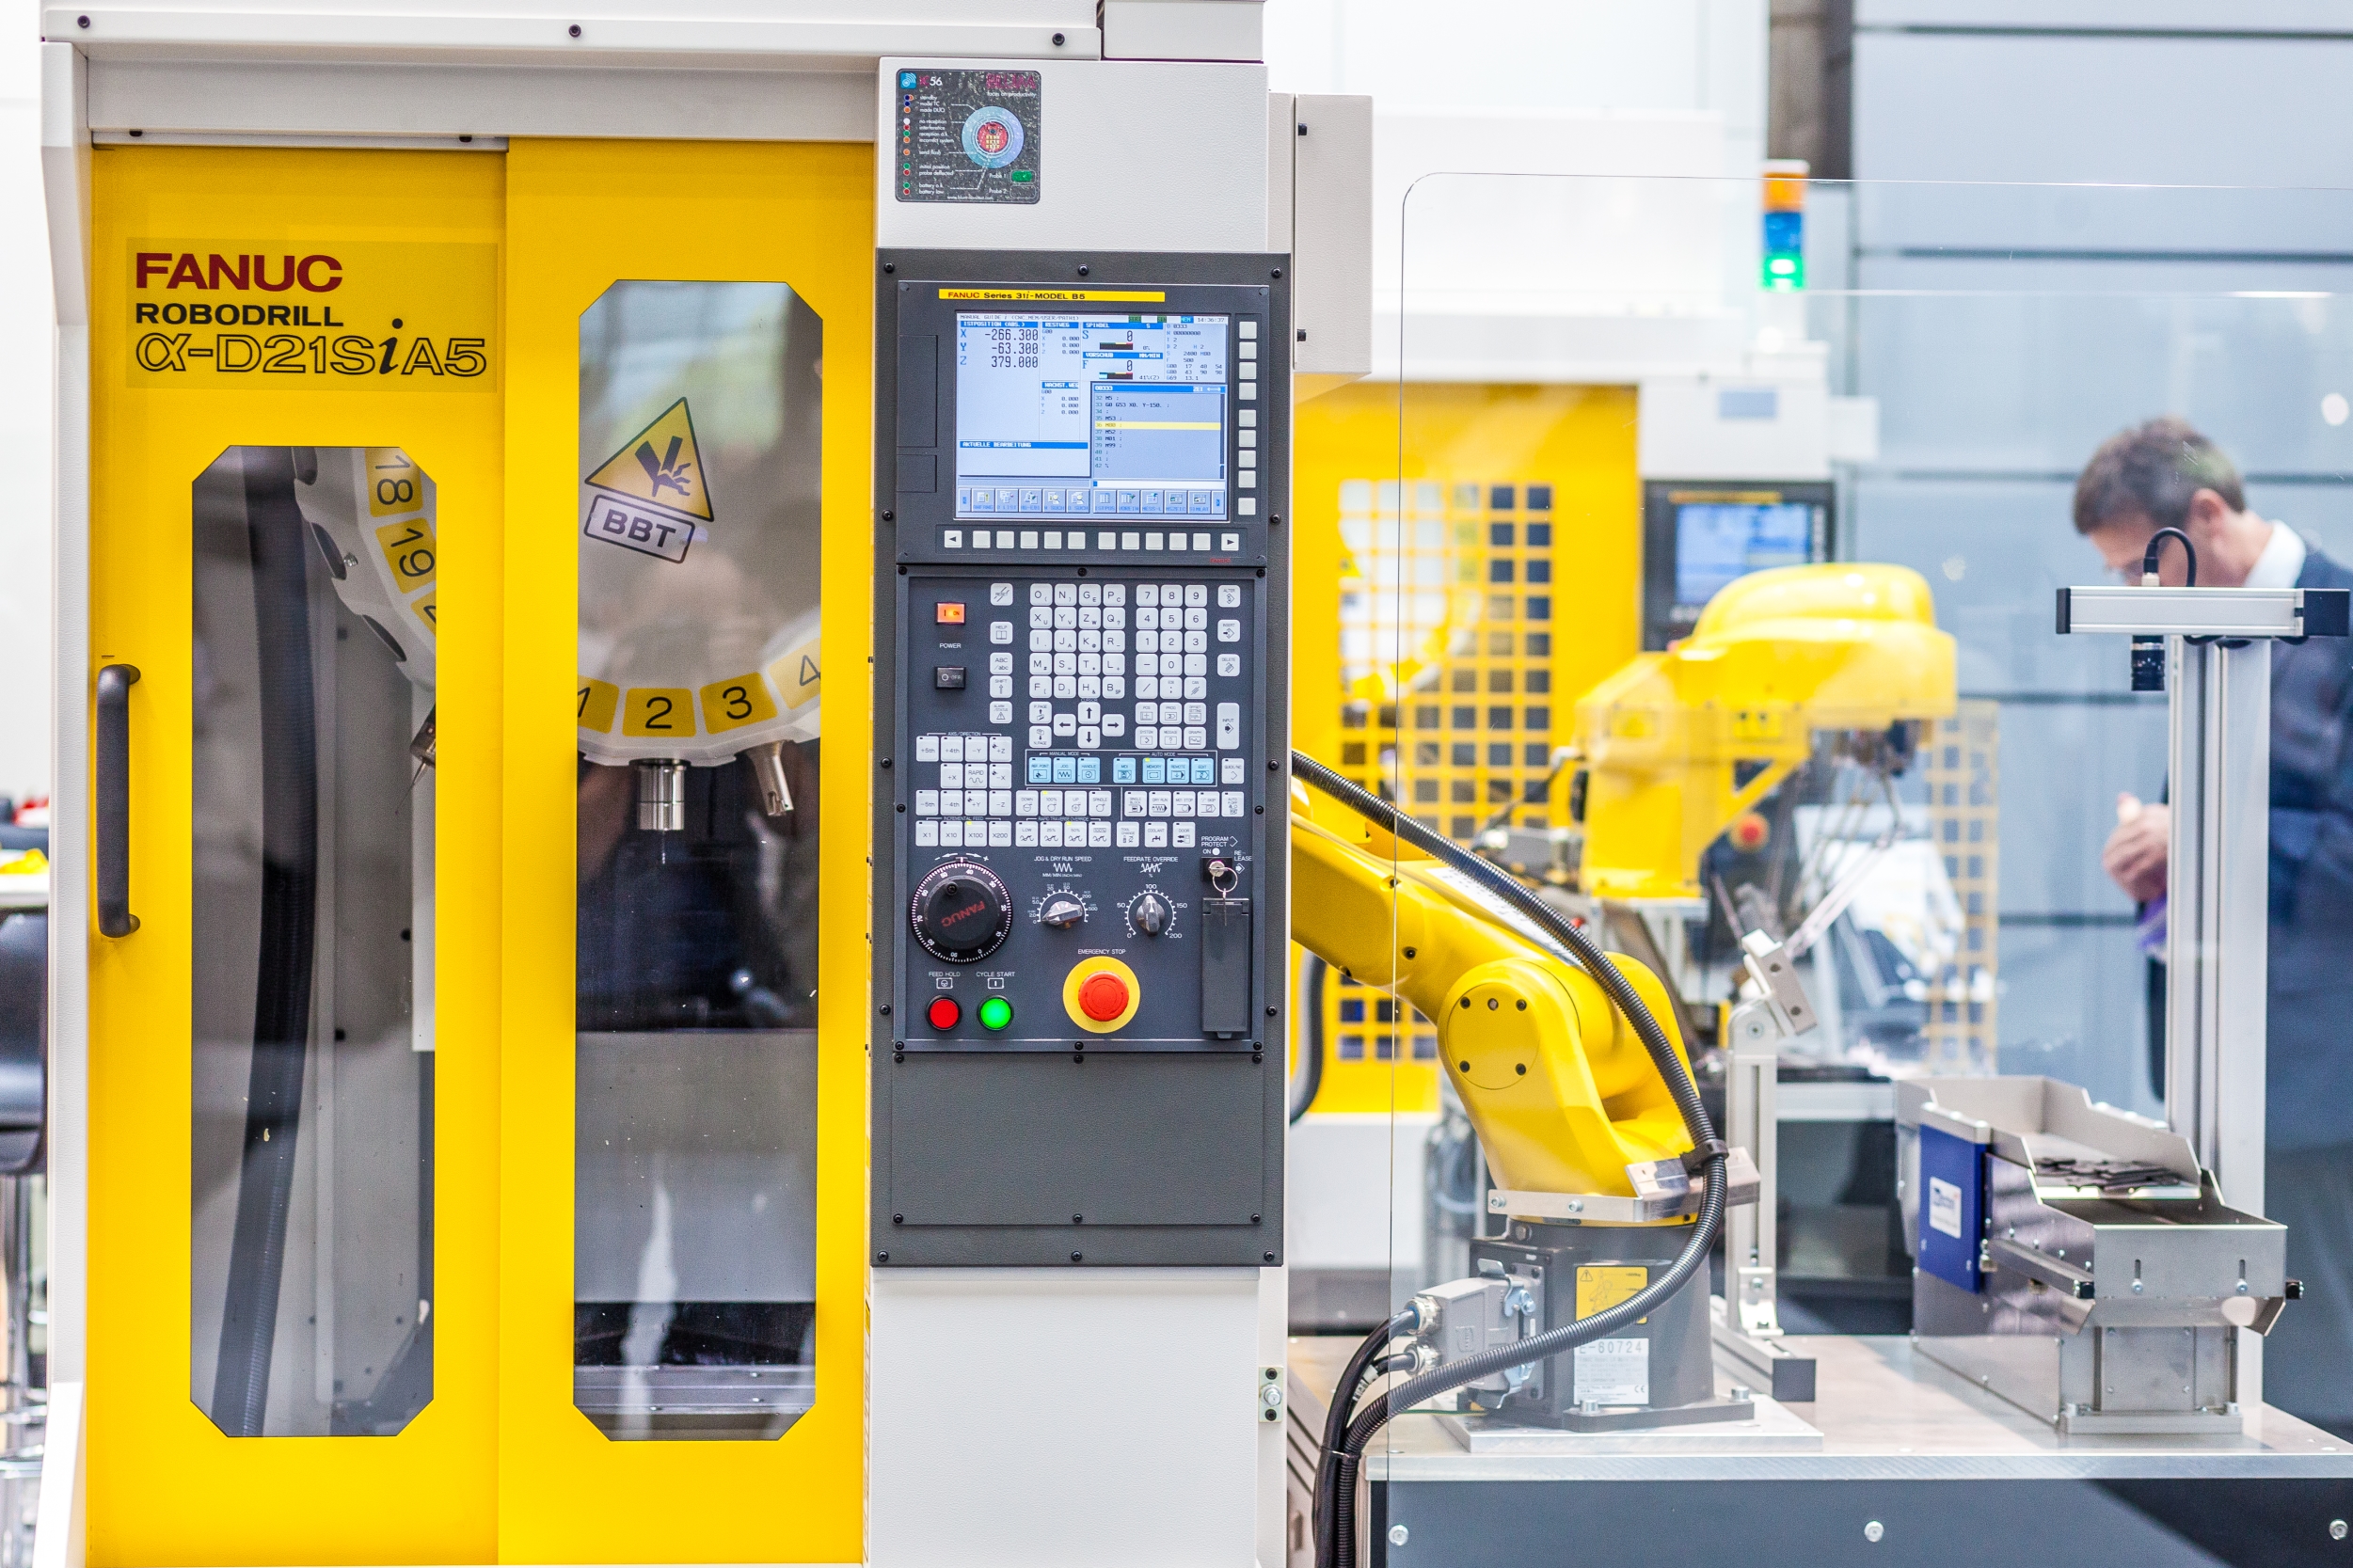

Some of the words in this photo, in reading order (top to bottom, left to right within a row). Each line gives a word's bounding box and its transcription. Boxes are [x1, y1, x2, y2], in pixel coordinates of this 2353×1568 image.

[136, 252, 342, 293] FANUC
[135, 303, 344, 326] ROBODRILL
[960, 328, 967, 339] X
[985, 328, 1039, 341] -266.300
[1082, 330, 1089, 340] S
[1127, 330, 1133, 342] 0
[960, 342, 967, 352] Y
[992, 342, 1039, 355] -63.300
[960, 356, 967, 366] Z
[991, 356, 1039, 368] 379.000
[1082, 360, 1089, 370] F
[1127, 360, 1133, 372] 0
[375, 454, 413, 505] 18
[602, 508, 676, 548] BBT
[390, 528, 436, 577] 19
[1083, 591, 1090, 599] G
[1193, 592, 1199, 600] 9
[1106, 614, 1114, 623] Q
[1059, 637, 1065, 645] J
[1083, 637, 1089, 645] K
[1169, 638, 1175, 646] 2
[1192, 638, 1199, 646] 3
[1058, 683, 1065, 691] D
[723, 686, 753, 721] 3
[645, 696, 673, 729] 2
[941, 900, 986, 928] FANUC
